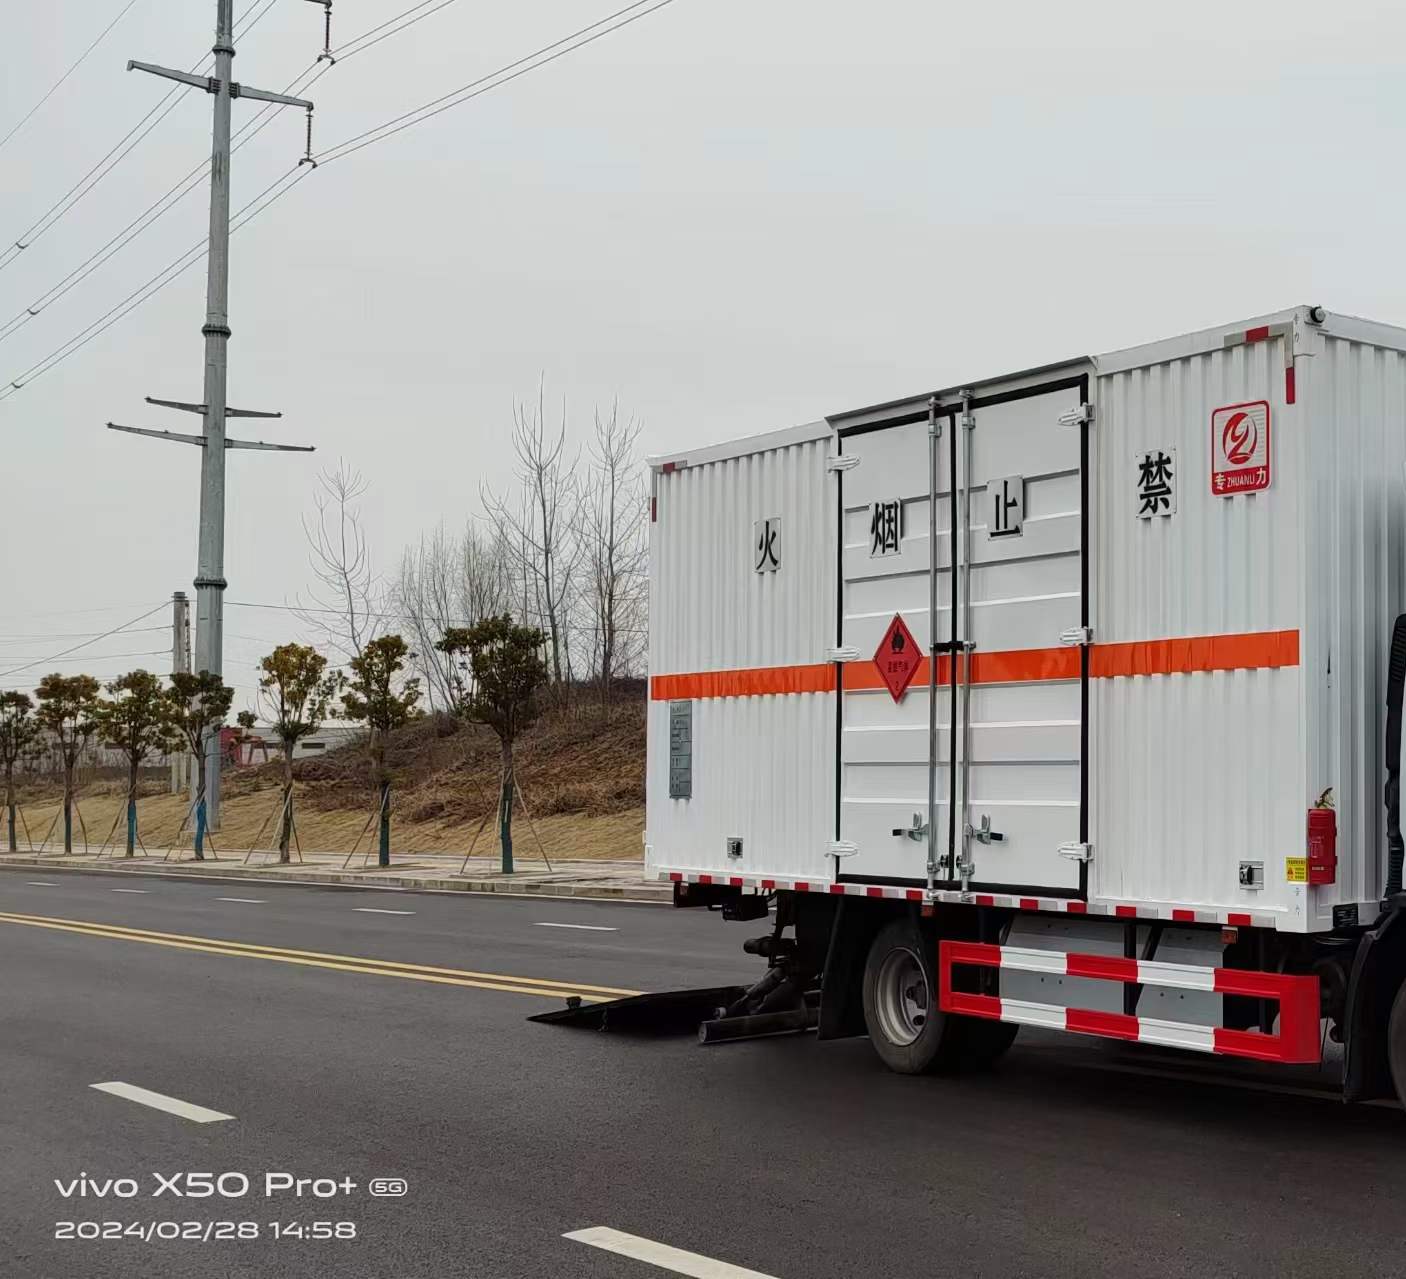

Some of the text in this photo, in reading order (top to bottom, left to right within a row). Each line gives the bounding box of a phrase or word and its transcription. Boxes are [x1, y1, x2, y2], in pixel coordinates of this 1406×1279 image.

[756, 452, 1173, 570] 禁 止 烟 火
[1227, 474, 1255, 488] ZHUANLI
[1256, 467, 1267, 485] 力
